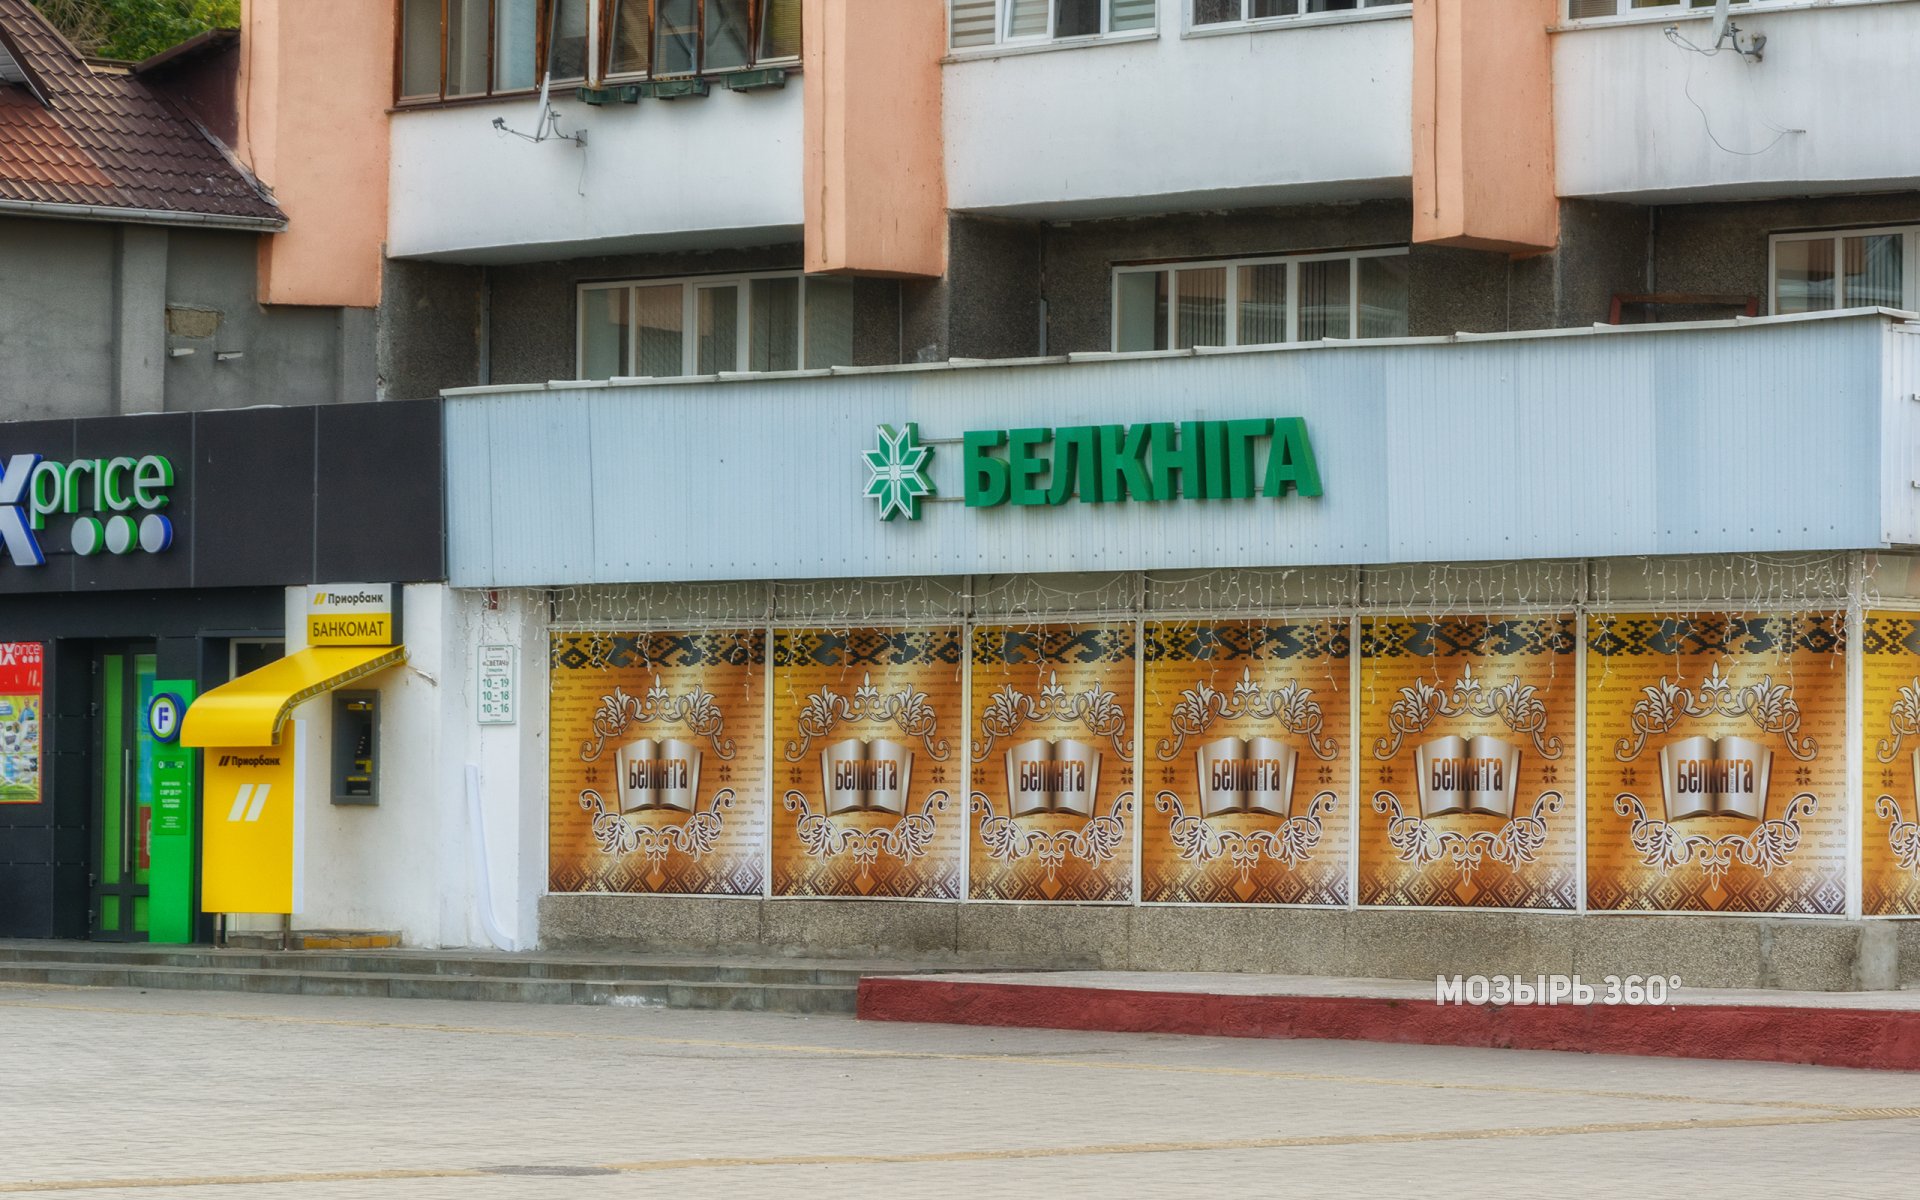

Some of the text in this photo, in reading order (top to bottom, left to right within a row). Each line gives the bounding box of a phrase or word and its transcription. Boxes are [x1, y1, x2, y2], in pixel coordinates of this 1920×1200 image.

[964, 417, 1323, 507] БЕЛКНІГА
[30, 455, 174, 530] price
[328, 591, 384, 606] Приорбанк
[313, 621, 384, 637] БАНКОМАТ
[482, 678, 492, 687] 10
[500, 678, 509, 687] 19
[482, 691, 492, 700] 10
[500, 691, 509, 700] 18
[482, 704, 492, 713] 10
[500, 704, 509, 713] 16
[158, 707, 169, 730] F
[231, 755, 281, 768] Приорбанк
